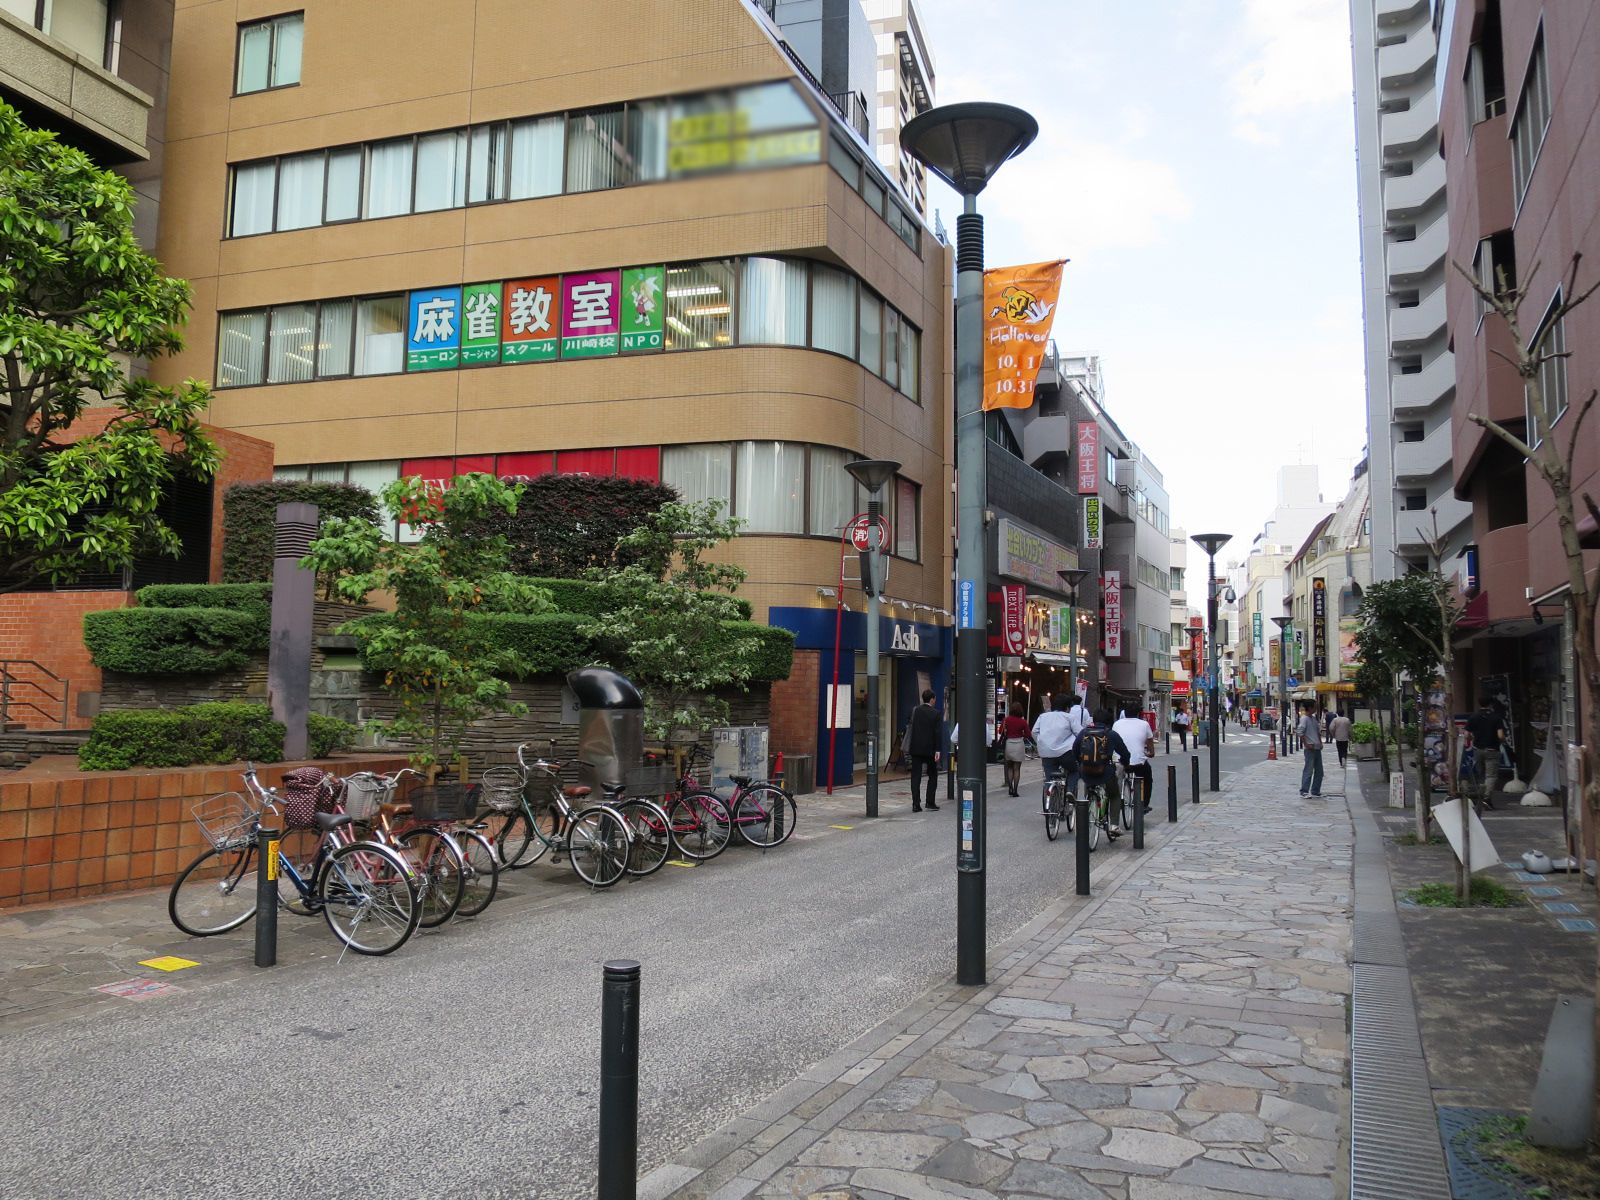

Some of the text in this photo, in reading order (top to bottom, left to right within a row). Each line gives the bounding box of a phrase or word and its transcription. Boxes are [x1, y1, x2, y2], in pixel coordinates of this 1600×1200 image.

[412, 280, 613, 344] 麻雀教室
[409, 351, 458, 364] ニューロン
[462, 348, 498, 360] マージャン
[505, 342, 554, 356] スクール
[623, 334, 661, 347] NPO
[996, 379, 1034, 394] 10.31
[1080, 426, 1095, 489] 大阪王将
[1106, 576, 1120, 635] 大阪王将
[891, 624, 920, 652] Ash
